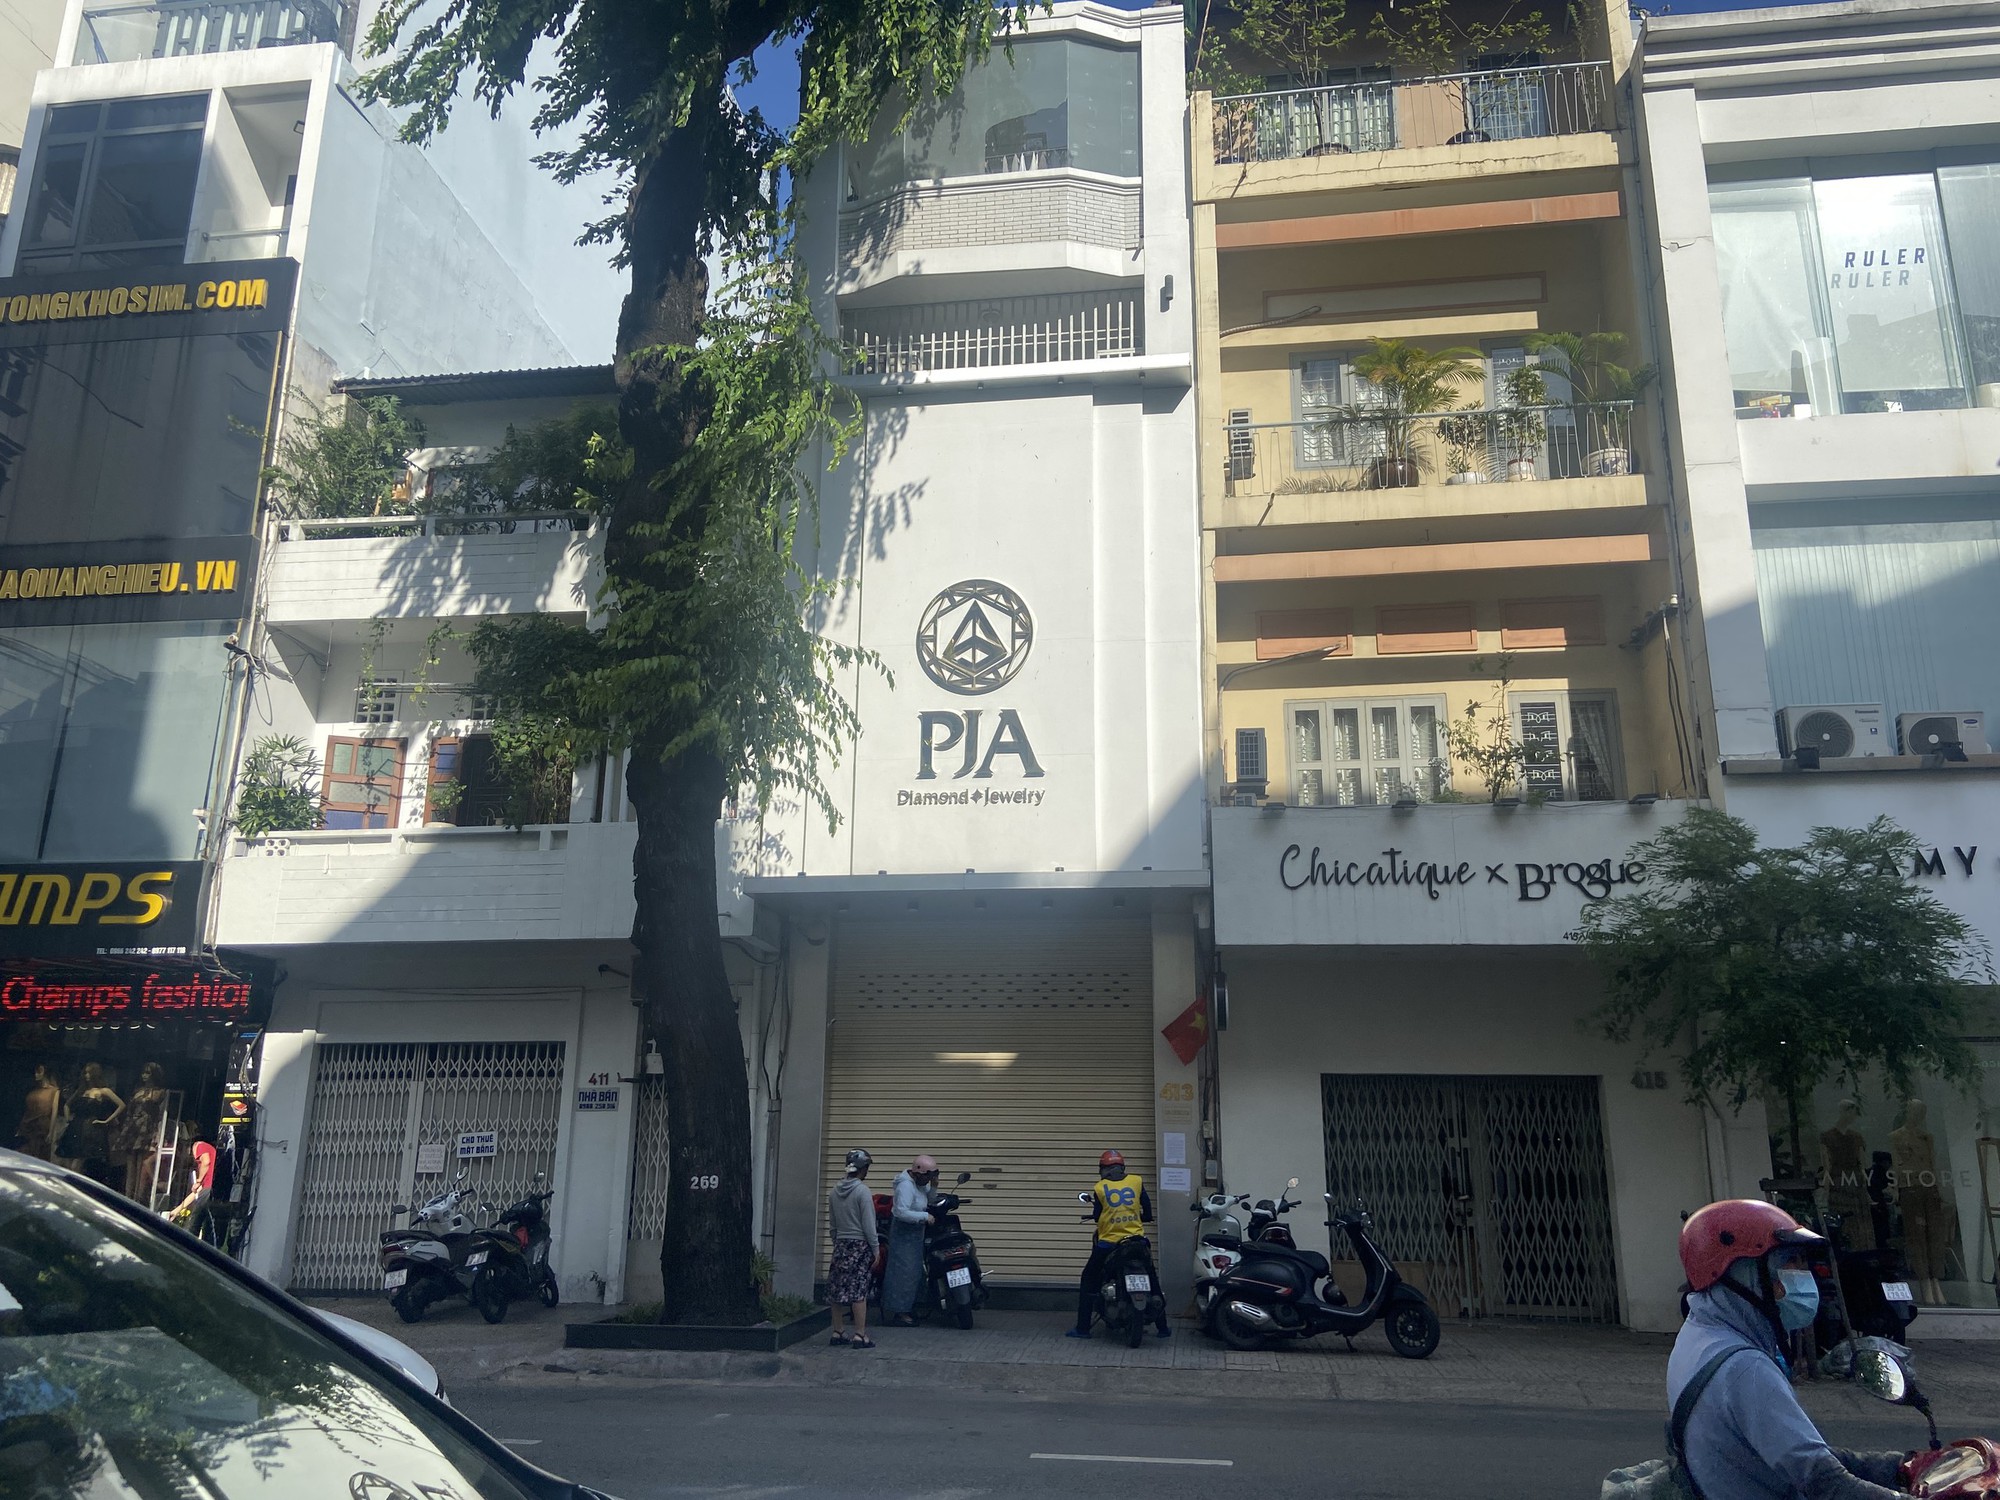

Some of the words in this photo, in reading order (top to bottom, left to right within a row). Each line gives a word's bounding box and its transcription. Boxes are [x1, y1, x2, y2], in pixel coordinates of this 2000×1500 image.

[1845, 247, 1925, 268] RULER
[915, 708, 1046, 780] PJA
[897, 788, 969, 806] Diamond
[983, 787, 1046, 807] Jewelry
[1279, 843, 1477, 901] Chicatique
[1515, 858, 1646, 901] Brogue
[1, 976, 131, 1015] Champs
[588, 1072, 609, 1086] 411
[578, 1089, 597, 1102] NHÀ
[598, 1089, 618, 1102] BÁN
[1160, 1082, 1194, 1101] 413
[461, 1135, 475, 1144] CHO
[689, 1174, 719, 1190] 269
[1819, 1169, 1874, 1187] AMY
[1103, 1183, 1136, 1208] be
